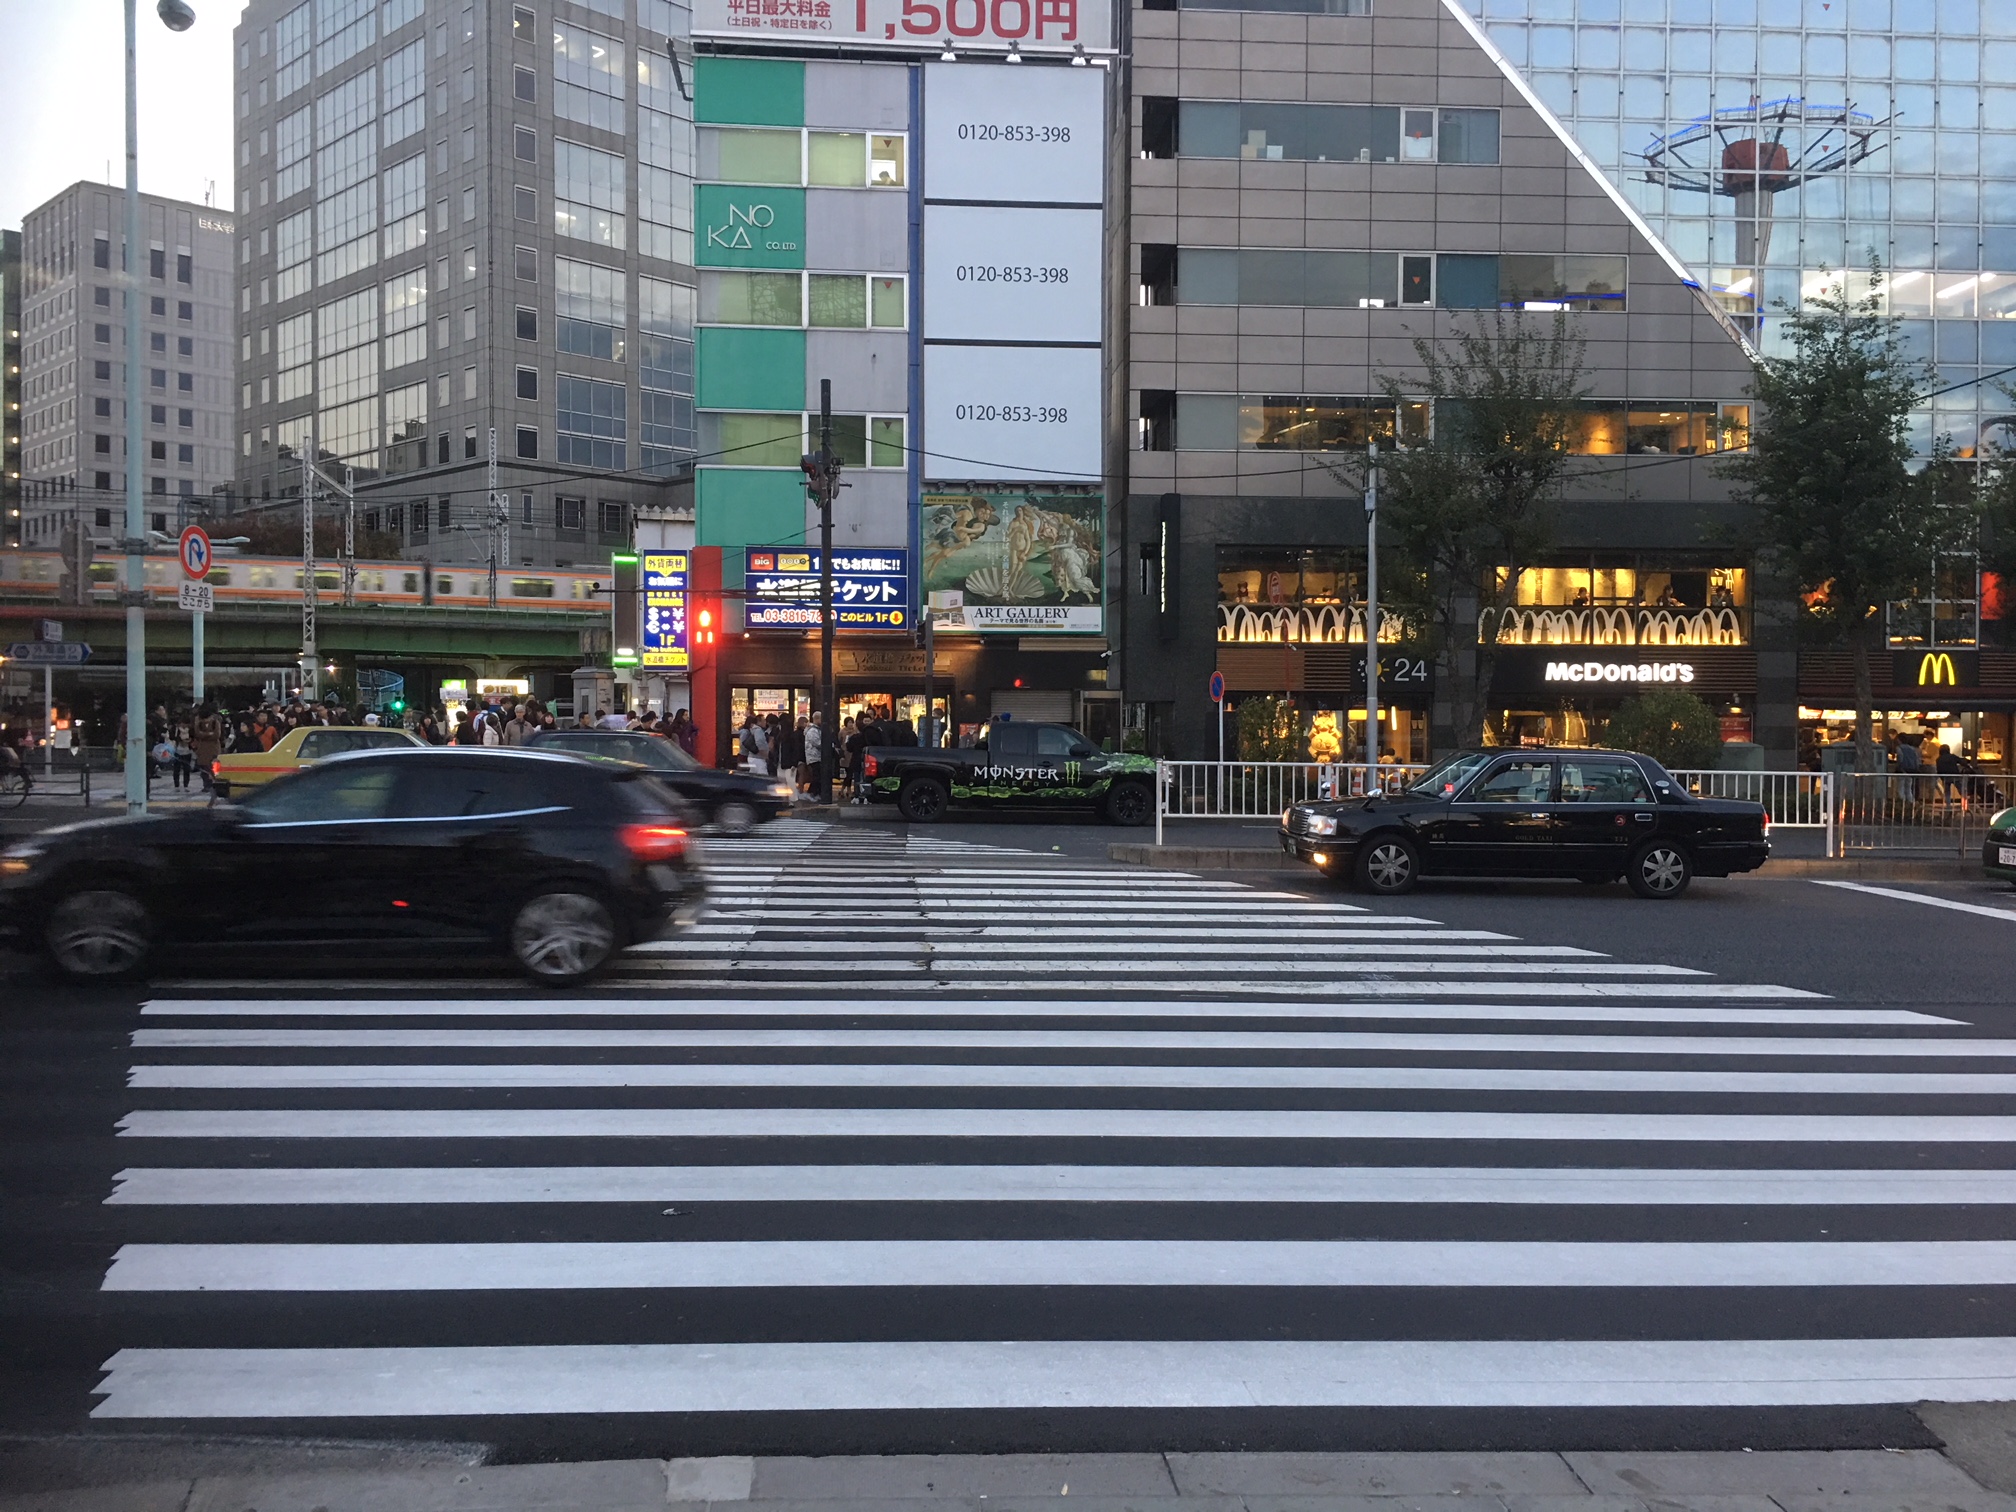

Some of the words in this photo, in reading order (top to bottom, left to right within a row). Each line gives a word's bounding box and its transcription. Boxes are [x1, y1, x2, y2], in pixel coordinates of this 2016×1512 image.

[727, 0, 831, 18] 平日最大料金
[958, 123, 1071, 143] 0120-853-398
[765, 241, 780, 250] CO.
[782, 242, 797, 251] LTD.
[956, 265, 1069, 284] 0120-853-398
[955, 404, 1068, 424] 0120-853-398
[648, 558, 683, 569] 外貨両替
[182, 599, 211, 609] ここから
[840, 612, 874, 623] このビル
[876, 612, 889, 623] 1F
[974, 608, 1003, 618] ART
[1006, 608, 1070, 618] GALLERY
[659, 633, 676, 646] 1F
[1394, 658, 1428, 682] 24
[1544, 661, 1695, 683] McDonald's
[974, 765, 1059, 780] MONSTER
